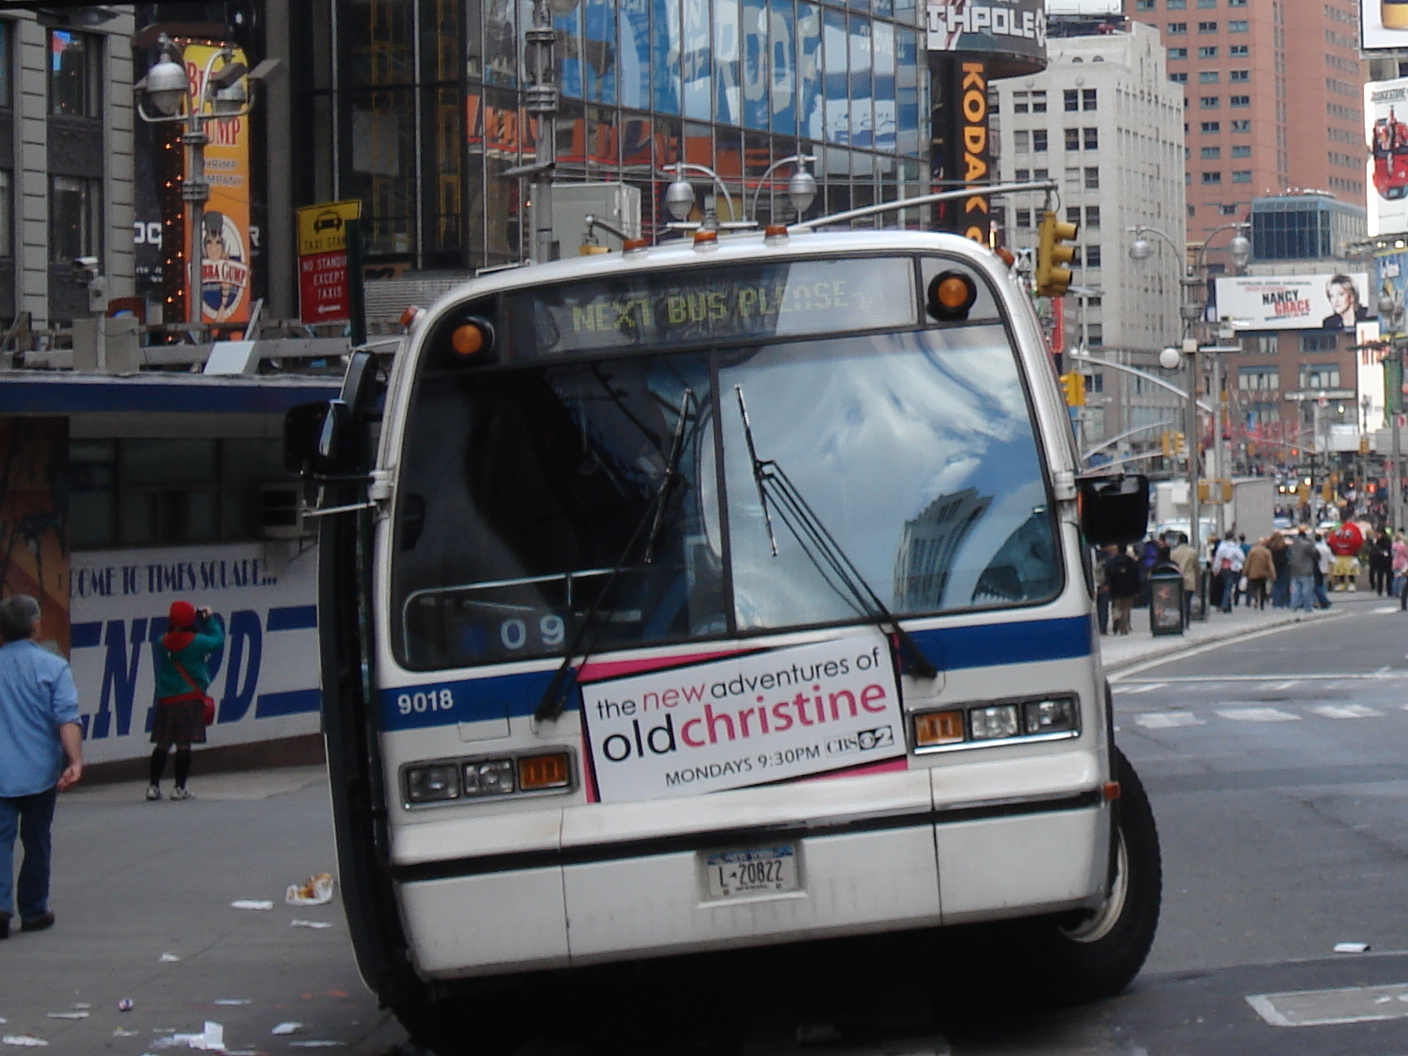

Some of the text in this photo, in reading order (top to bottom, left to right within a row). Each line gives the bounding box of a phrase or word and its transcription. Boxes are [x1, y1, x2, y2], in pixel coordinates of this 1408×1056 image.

[203, 116, 241, 147] UMP
[961, 62, 988, 215] KODAK
[205, 175, 243, 187] MPANY
[304, 234, 347, 251] TAXI STA
[302, 255, 347, 273] NO STANDI
[313, 270, 345, 286] EXCEPT
[317, 286, 342, 300] TAXIS
[572, 280, 848, 333] NEXT BUS PLEASE
[1262, 289, 1299, 306] NANCY
[1274, 299, 1311, 316] GRACE
[122, 565, 140, 595] TO
[147, 561, 197, 594] TIMES
[92, 609, 263, 741] ND
[596, 647, 882, 721] the new adventures of
[398, 688, 454, 715] 9018
[602, 682, 889, 763] old christine
[665, 758, 754, 788] MONDAYS
[757, 744, 822, 769] 9:30PM
